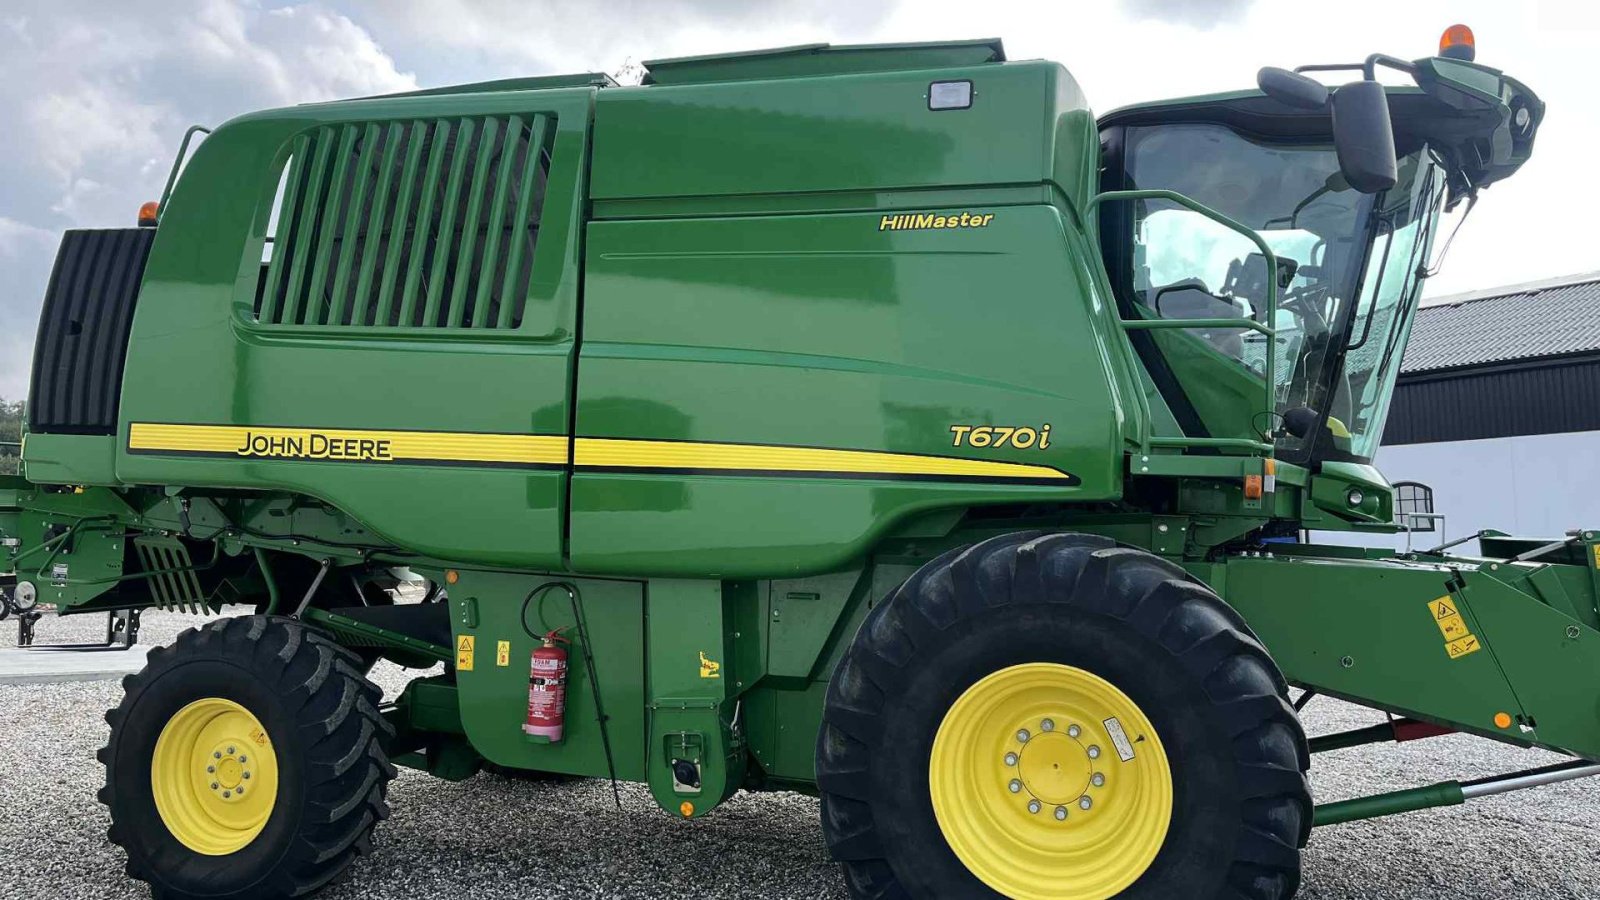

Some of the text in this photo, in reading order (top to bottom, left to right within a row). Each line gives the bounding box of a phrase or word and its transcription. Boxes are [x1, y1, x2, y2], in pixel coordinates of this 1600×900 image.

[879, 212, 994, 231] HillMaster
[238, 432, 391, 458] JOHN DEERE
[950, 423, 1051, 450] T670i
